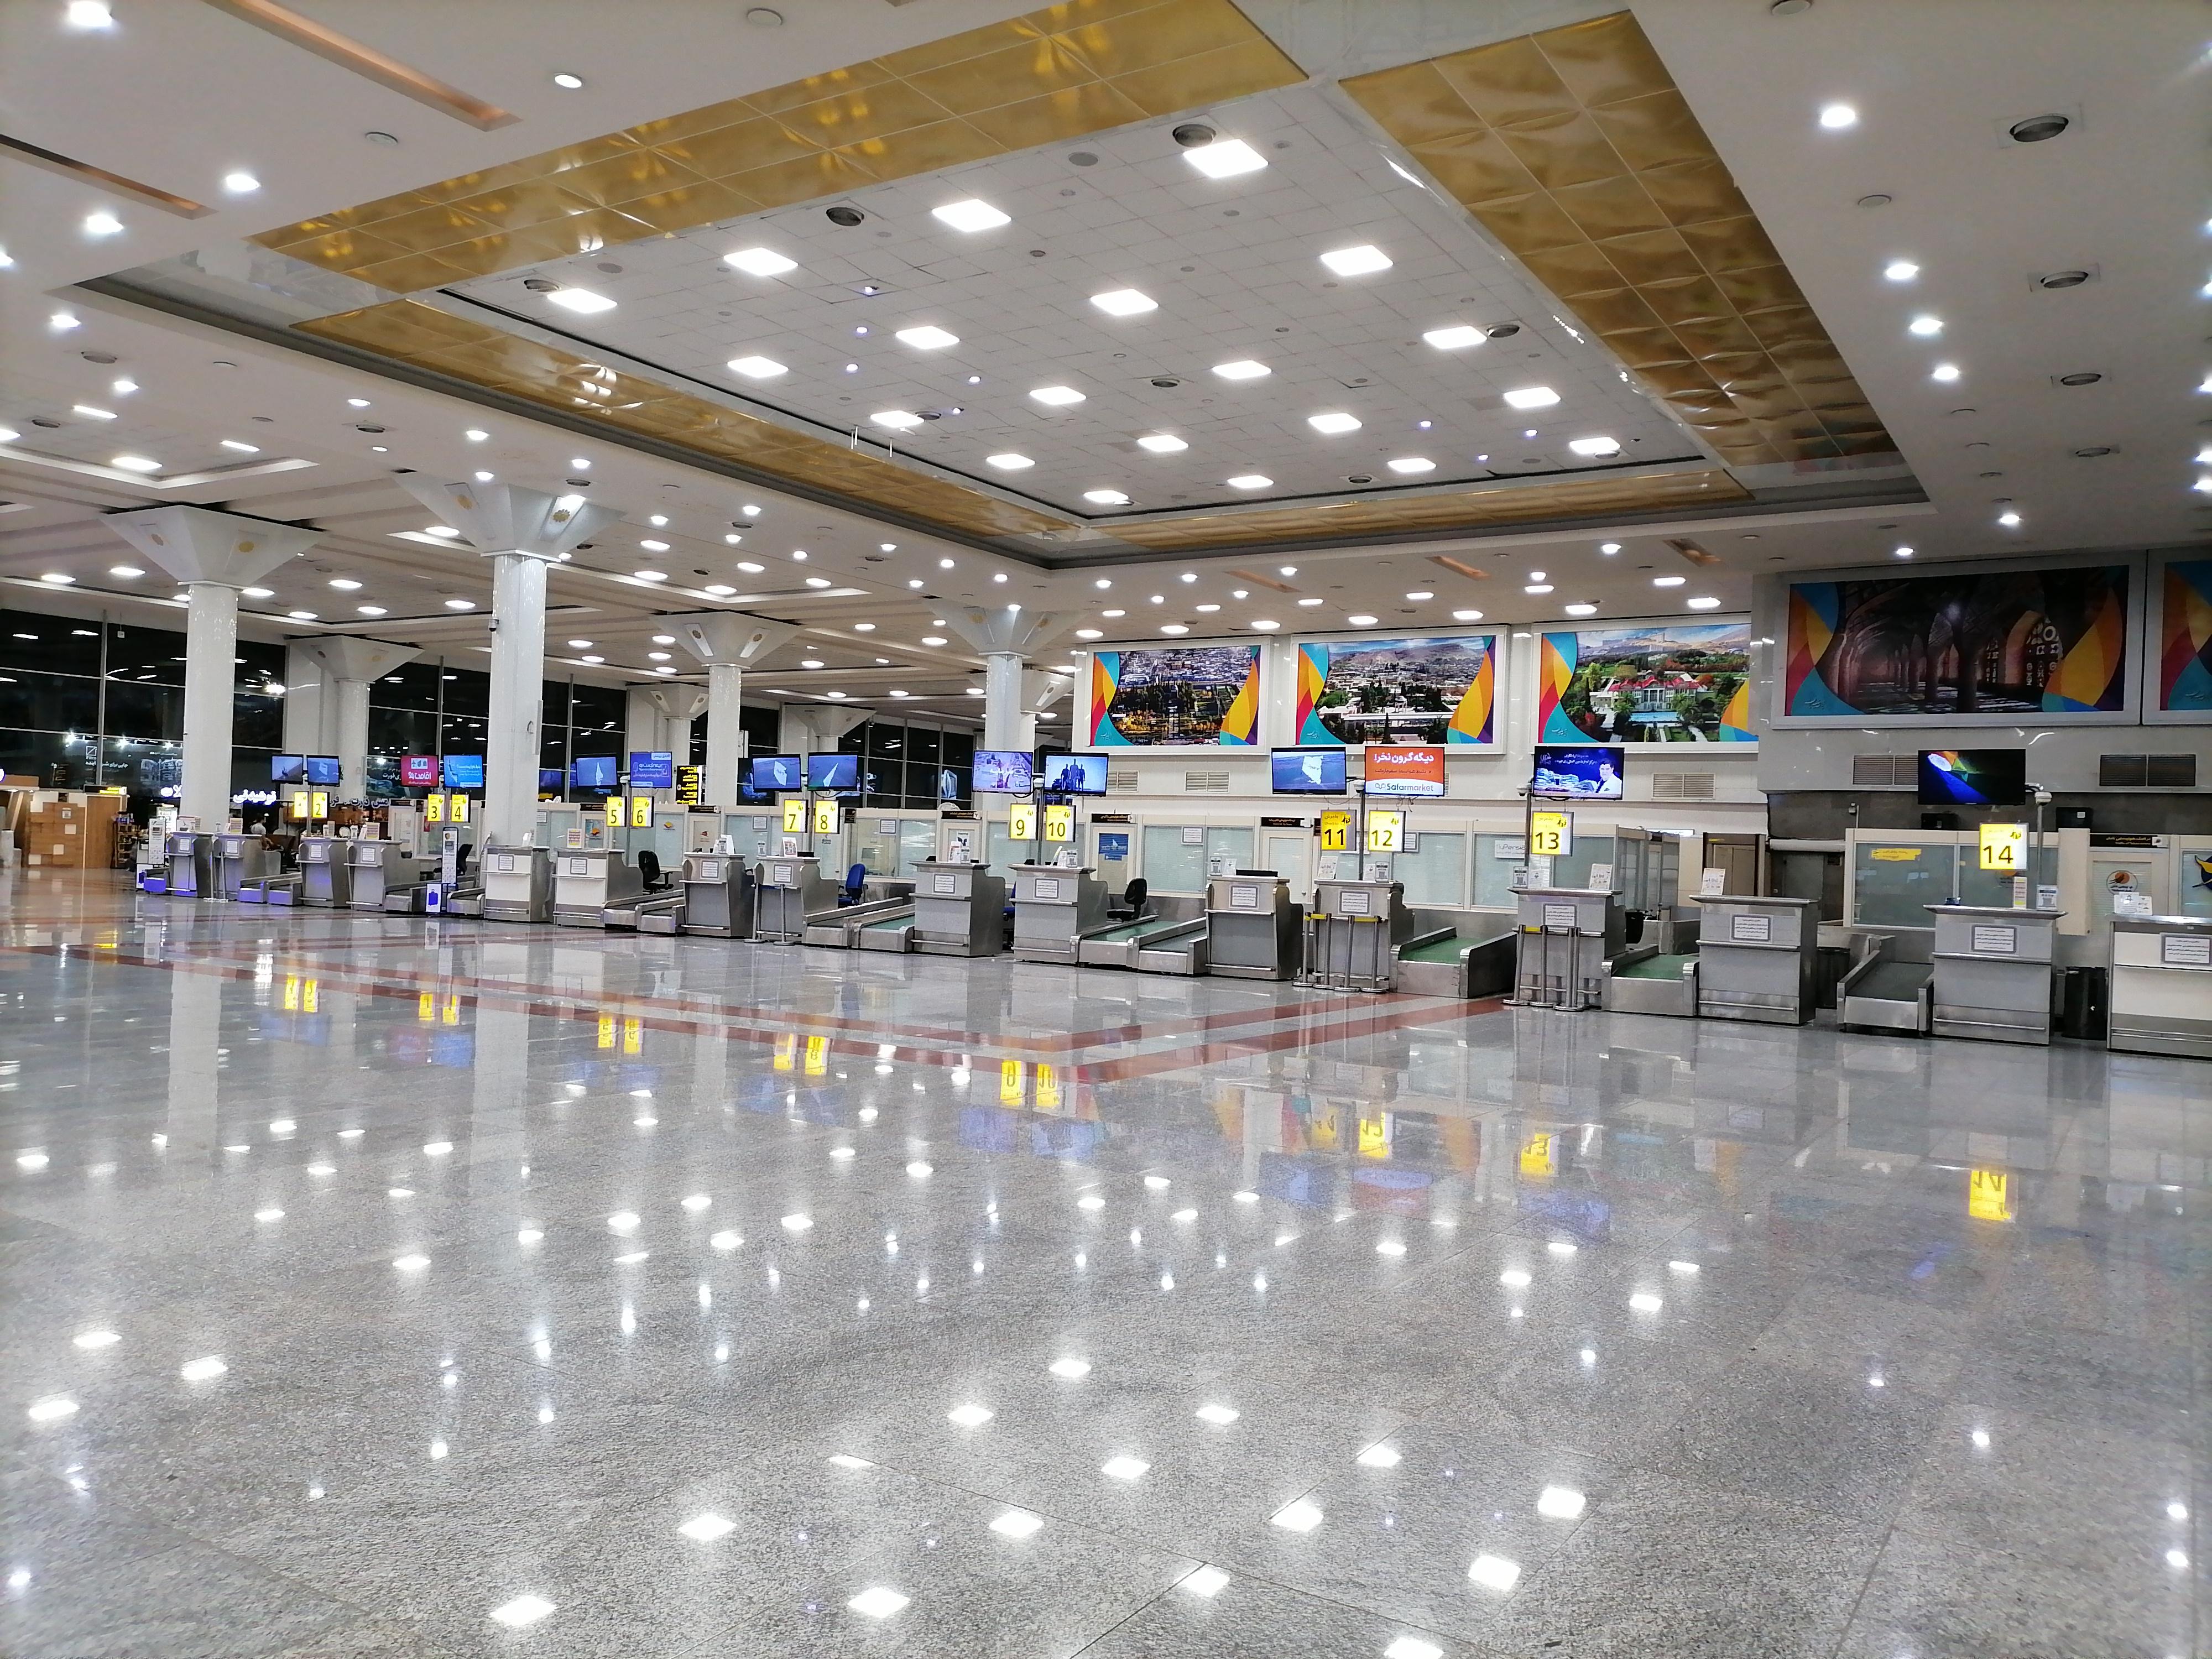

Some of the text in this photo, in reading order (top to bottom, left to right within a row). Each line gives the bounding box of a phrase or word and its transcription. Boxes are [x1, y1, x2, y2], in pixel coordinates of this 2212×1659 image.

[1387, 783, 1433, 791] Safarmarket
[316, 804, 321, 816] 2
[431, 806, 437, 819] 3
[455, 806, 461, 820] 4
[611, 810, 617, 824] 5
[637, 810, 643, 824] 6
[789, 814, 796, 829] 7
[820, 815, 828, 830] 8
[1016, 820, 1025, 836] 9
[1048, 822, 1066, 837] 10
[1324, 828, 1344, 846] 11
[1371, 830, 1392, 847] 12
[1535, 832, 1559, 850] 13
[1983, 845, 2013, 864] 14
